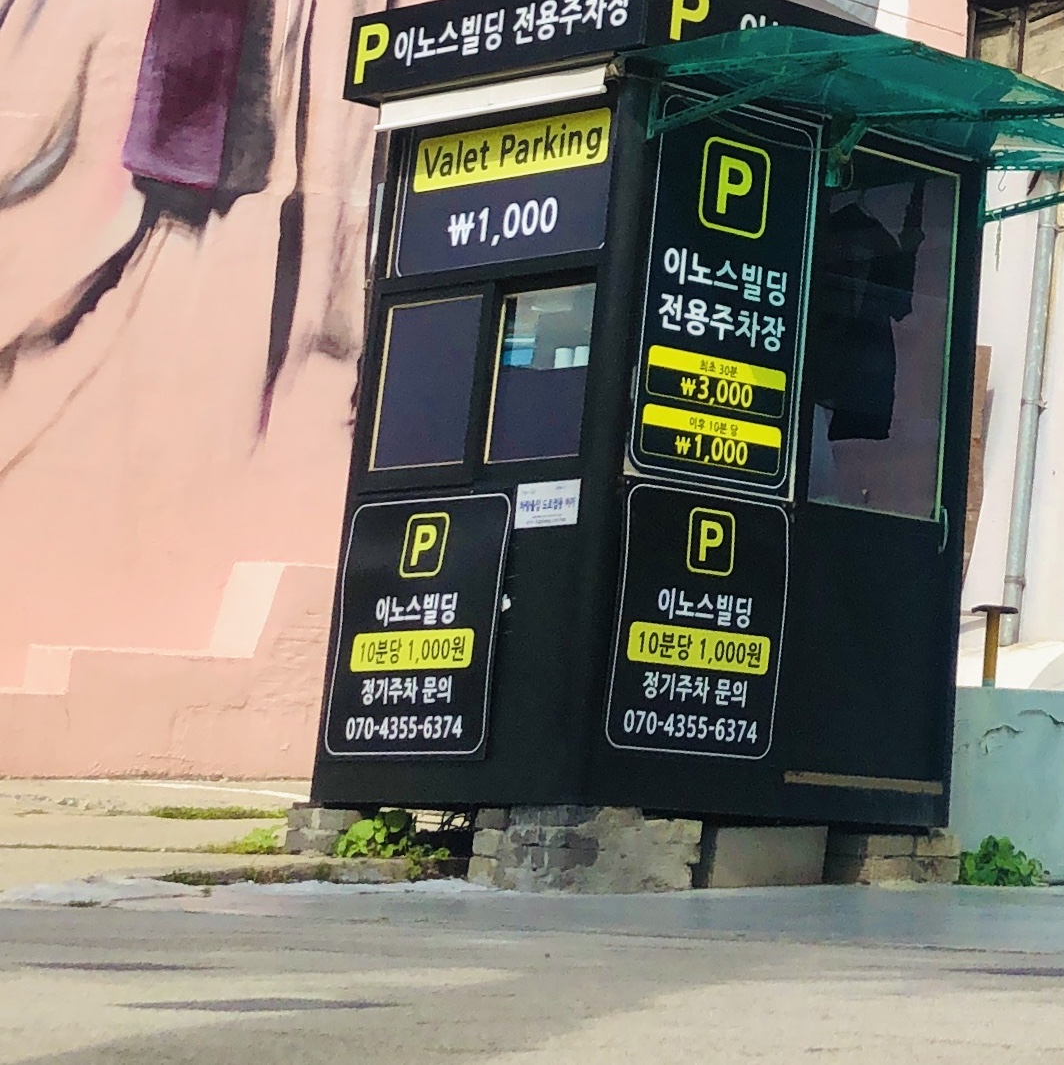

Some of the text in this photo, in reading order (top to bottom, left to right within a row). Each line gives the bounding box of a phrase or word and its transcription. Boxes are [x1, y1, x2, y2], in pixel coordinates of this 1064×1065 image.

[353, 22, 390, 85] P
[394, 8, 505, 67] 이노스빌딩
[424, 123, 603, 179] Valet Parking
[716, 155, 753, 215] P
[447, 196, 558, 247] ₩1,000
[663, 247, 788, 307] 이노스빌딩
[658, 292, 786, 352] 전용주차장
[699, 359, 738, 378] 최초 30분
[680, 375, 753, 408] ₩3,000
[689, 416, 705, 431] 이후
[675, 434, 748, 466] ₩1,000
[409, 524, 438, 567] P
[698, 519, 724, 562] P
[375, 592, 459, 627] 이노스빌딩
[658, 588, 753, 629] 이노스빌딩
[360, 635, 466, 665] 10분당 1,000원
[639, 631, 762, 669] 10분당 1,000원
[361, 675, 453, 706] 정기주차 문의
[642, 670, 748, 708] 정기주차 문의
[345, 715, 463, 740] 070-4355-6374
[623, 709, 758, 745] 070-4355-6374
